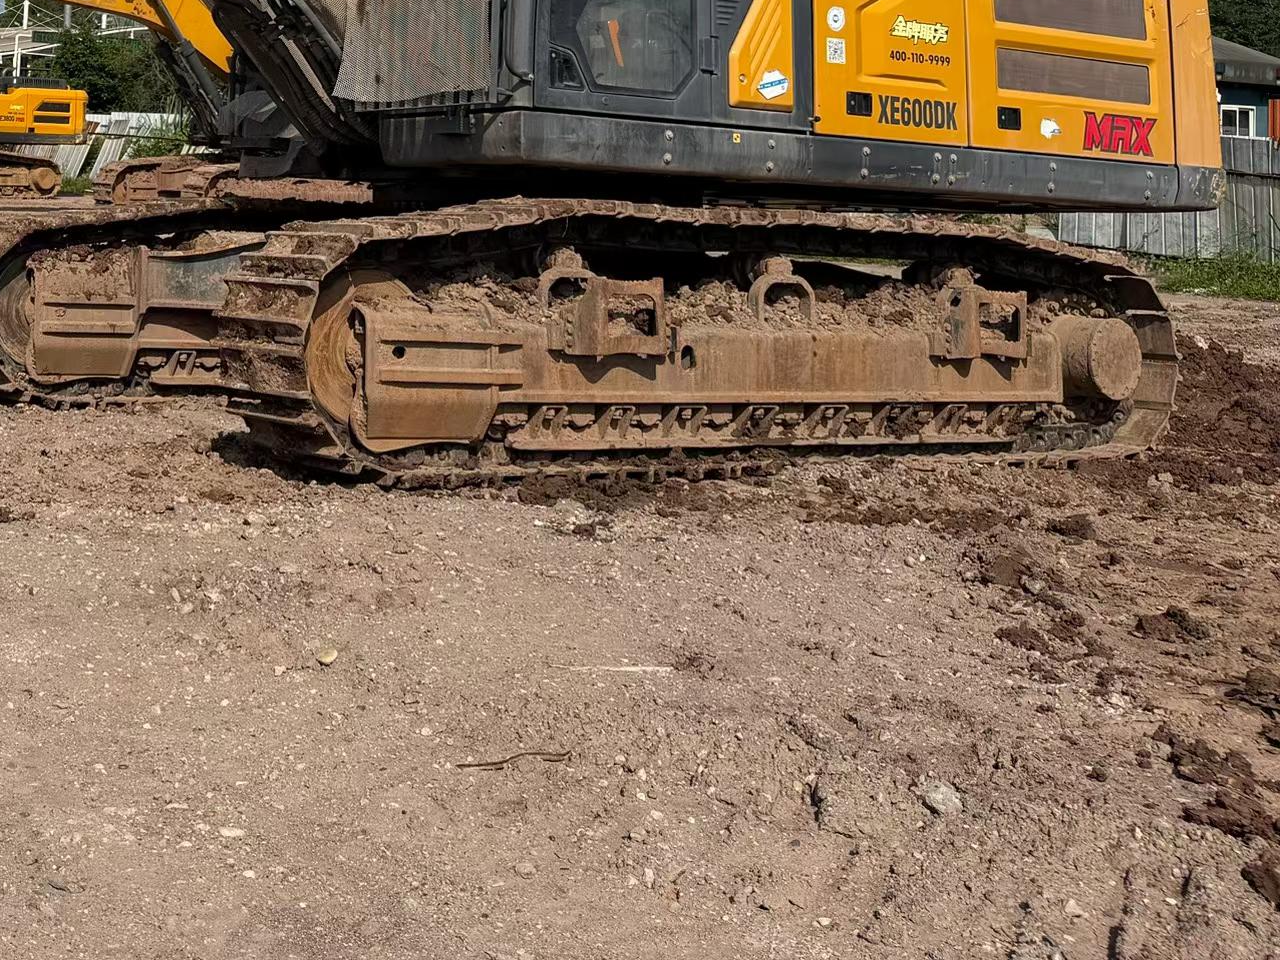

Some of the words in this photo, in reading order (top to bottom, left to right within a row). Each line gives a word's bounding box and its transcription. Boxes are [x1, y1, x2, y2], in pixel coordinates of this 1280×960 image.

[889, 15, 949, 45] 金牌服务
[889, 50, 951, 67] 400-110-9999
[878, 94, 958, 131] XE600DK
[1083, 110, 1158, 158] MAX
